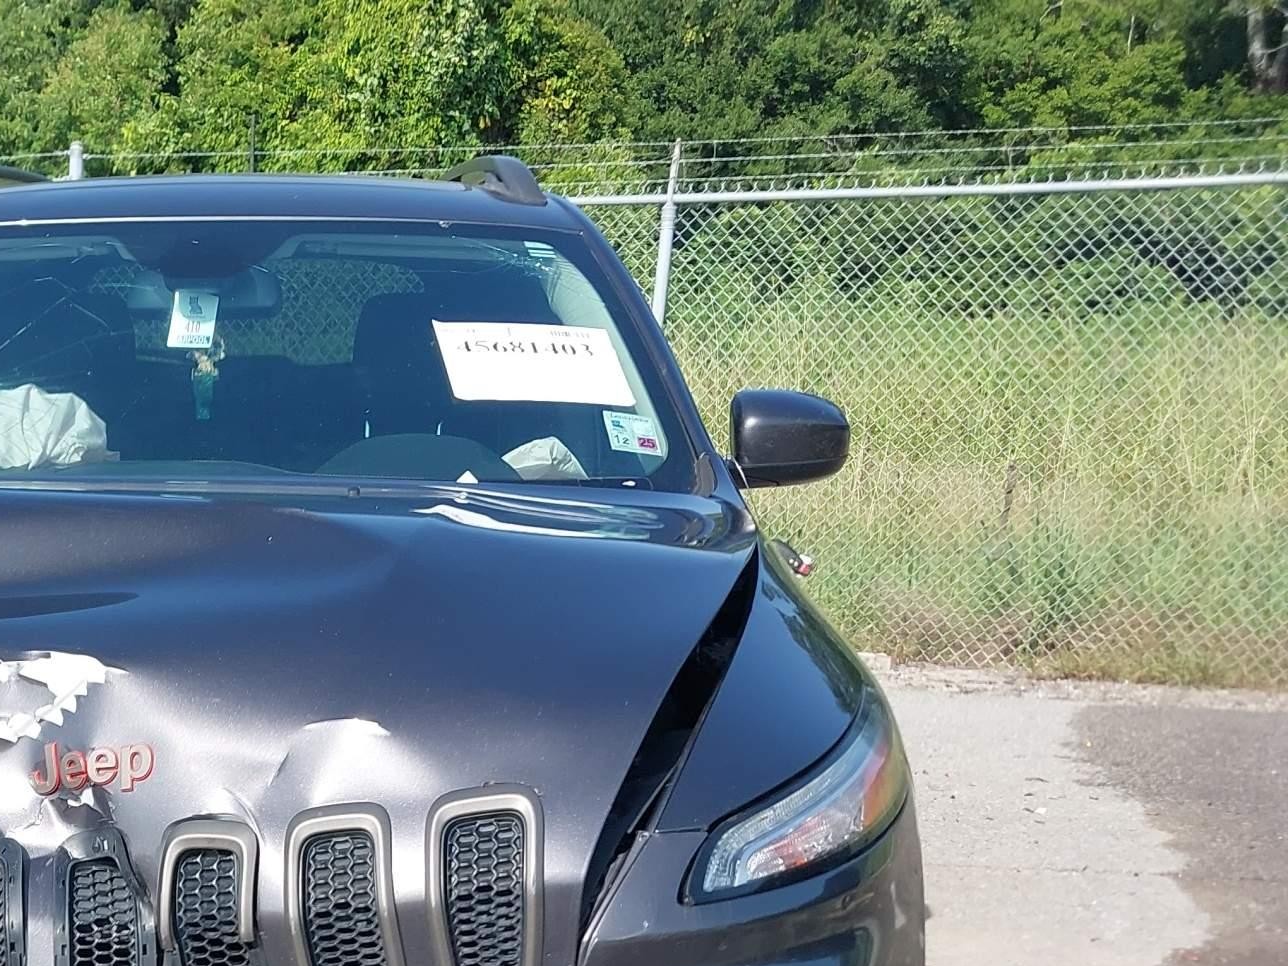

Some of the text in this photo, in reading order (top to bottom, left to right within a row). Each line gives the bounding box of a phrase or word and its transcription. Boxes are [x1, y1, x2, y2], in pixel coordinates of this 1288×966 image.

[456, 340, 593, 357] 45681403
[614, 434, 656, 449] 12 25
[30, 741, 156, 796] Jeep
